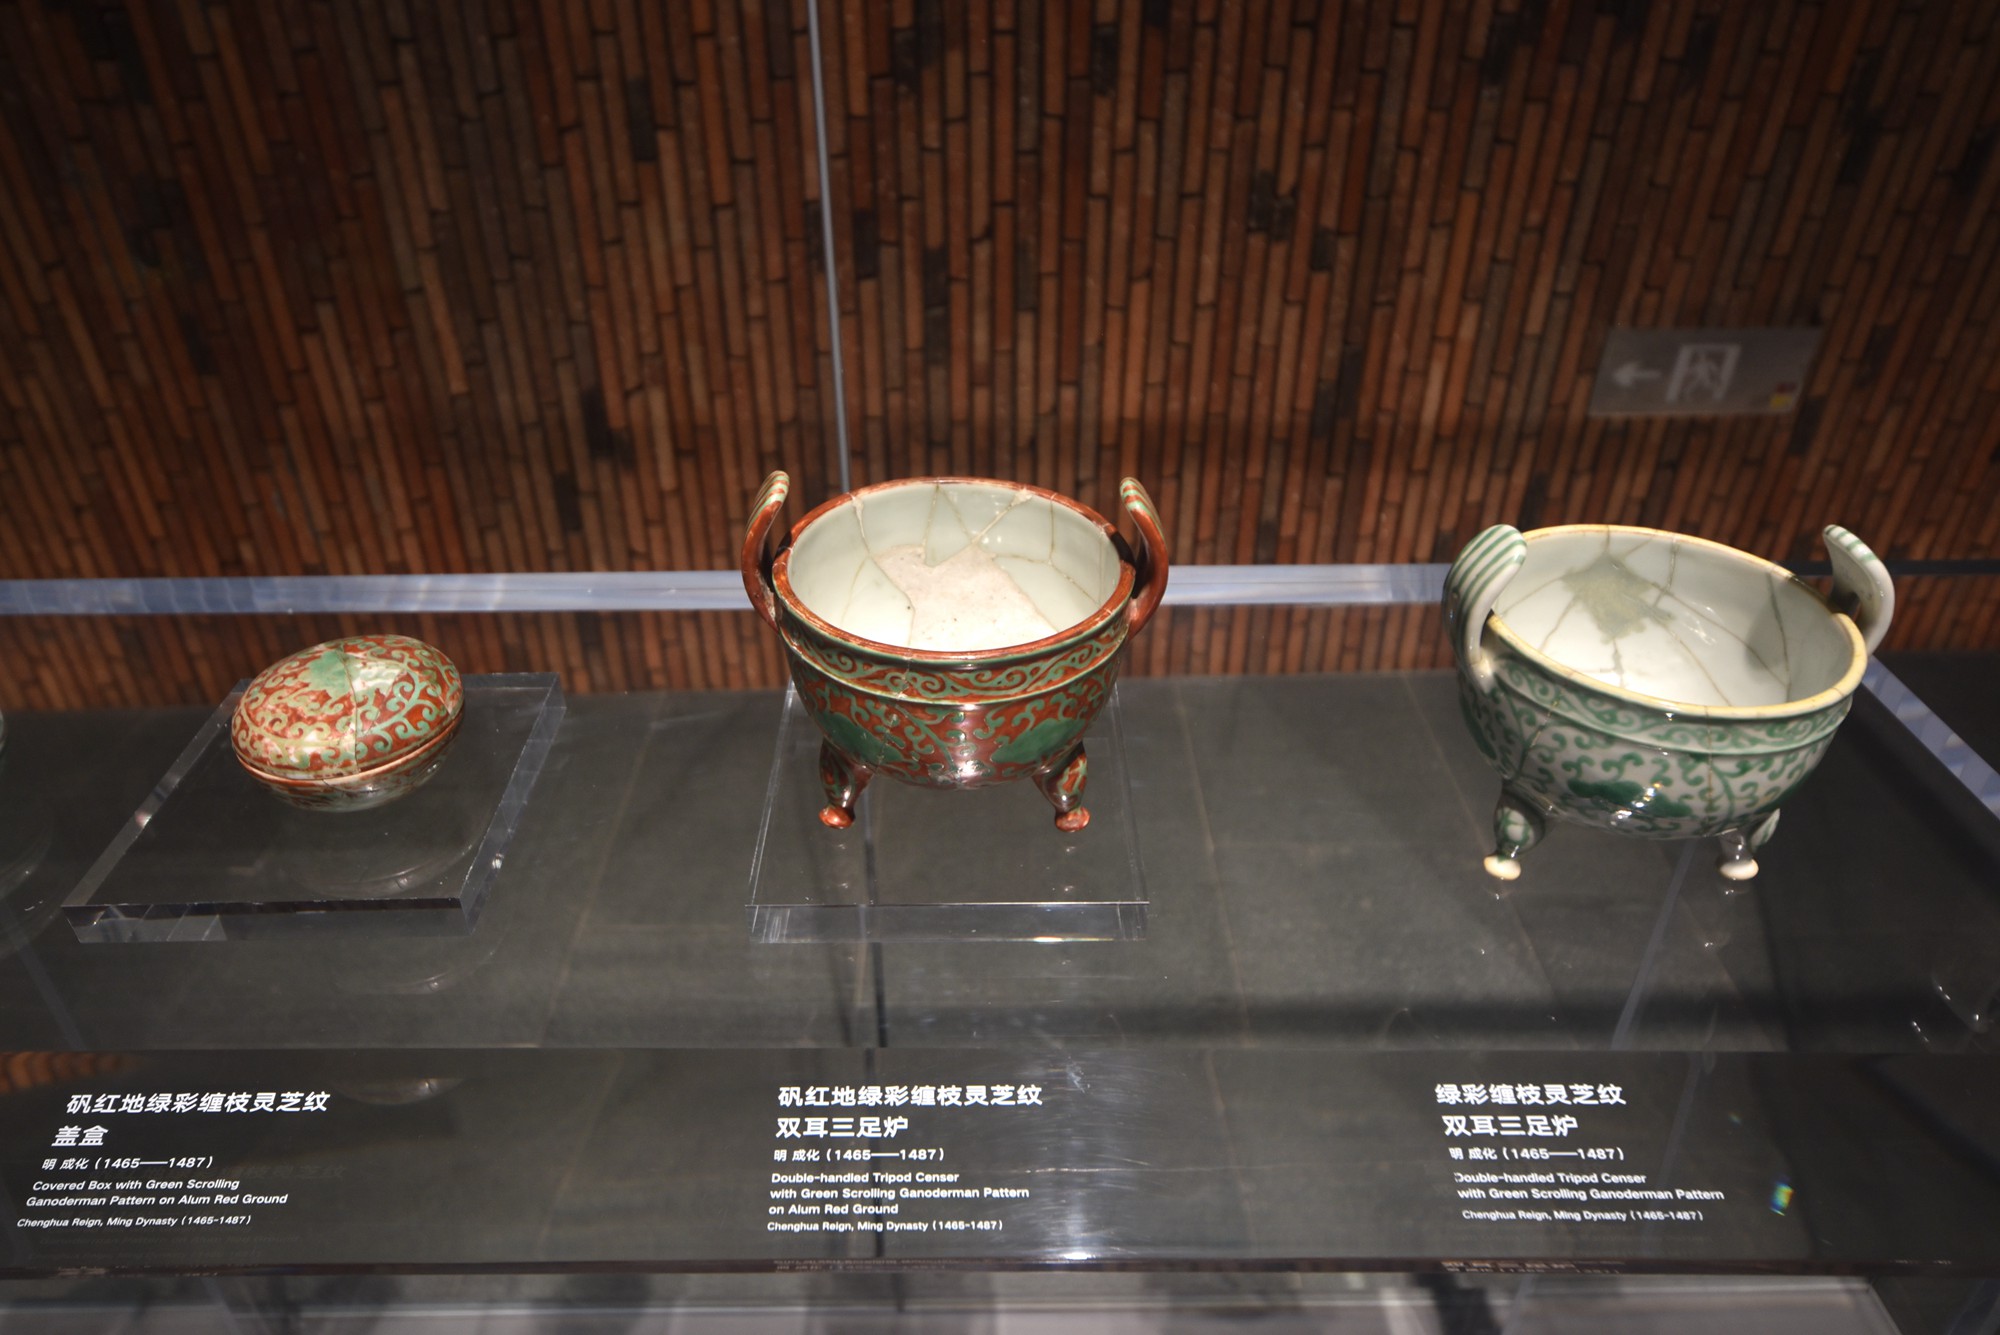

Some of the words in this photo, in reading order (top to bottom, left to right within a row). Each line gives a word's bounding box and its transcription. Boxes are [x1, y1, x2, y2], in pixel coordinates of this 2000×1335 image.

[777, 1083, 1043, 1108] 矾红地绿彩缠枝灵芝纹
[1434, 1082, 1627, 1106] 绿彩缠枝灵芝纹
[65, 1090, 332, 1115] 矾红地绿彩缠枝灵芝纹
[775, 1115, 909, 1139] 双耳三足炉
[1441, 1113, 1579, 1138] 双耳三足炉
[50, 1124, 109, 1147] 盖盒
[32, 1180, 87, 1192] Covered
[87, 1180, 113, 1191] Box
[115, 1179, 143, 1190] with
[145, 1179, 184, 1190] Green
[186, 1178, 241, 1191] Scrolling
[771, 1171, 870, 1184] Double-handled
[872, 1171, 913, 1185] Tripod
[915, 1171, 960, 1183] Censer
[1555, 1172, 1600, 1186] Tripod
[1600, 1172, 1647, 1184] Censer
[25, 1195, 107, 1207] Ganoderman
[109, 1195, 156, 1206] Pattern
[158, 1196, 176, 1206] on
[177, 1194, 211, 1205] Alum
[213, 1193, 240, 1205] Red
[241, 1193, 289, 1205] Ground
[769, 1187, 798, 1200] with
[800, 1187, 839, 1199] Green
[842, 1187, 896, 1201] Scrolling
[898, 1186, 980, 1199] Ganoderman
[983, 1186, 1030, 1199] Pattern
[1456, 1187, 1487, 1199] with
[1488, 1187, 1529, 1200] Green
[1530, 1187, 1588, 1202] Scrolling
[1588, 1187, 1674, 1200] Ganoderman
[1674, 1188, 1725, 1201] Pattern
[768, 1205, 785, 1215] on
[787, 1203, 821, 1215] Alum
[824, 1203, 849, 1215] Red
[852, 1203, 899, 1215] Ground
[1461, 1209, 1517, 1222] Chenghua
[1517, 1209, 1552, 1222] Reign,
[1552, 1209, 1582, 1222] Ming
[1582, 1209, 1628, 1222] Dynasty
[16, 1217, 70, 1229] Chenghua
[71, 1217, 104, 1229] Reign,
[106, 1216, 134, 1228] Ming
[134, 1216, 179, 1228] Dynasty
[766, 1221, 820, 1233] Chenghua
[821, 1221, 855, 1233] Reign,
[856, 1220, 884, 1233] Ming
[885, 1220, 929, 1233] Dynasty
